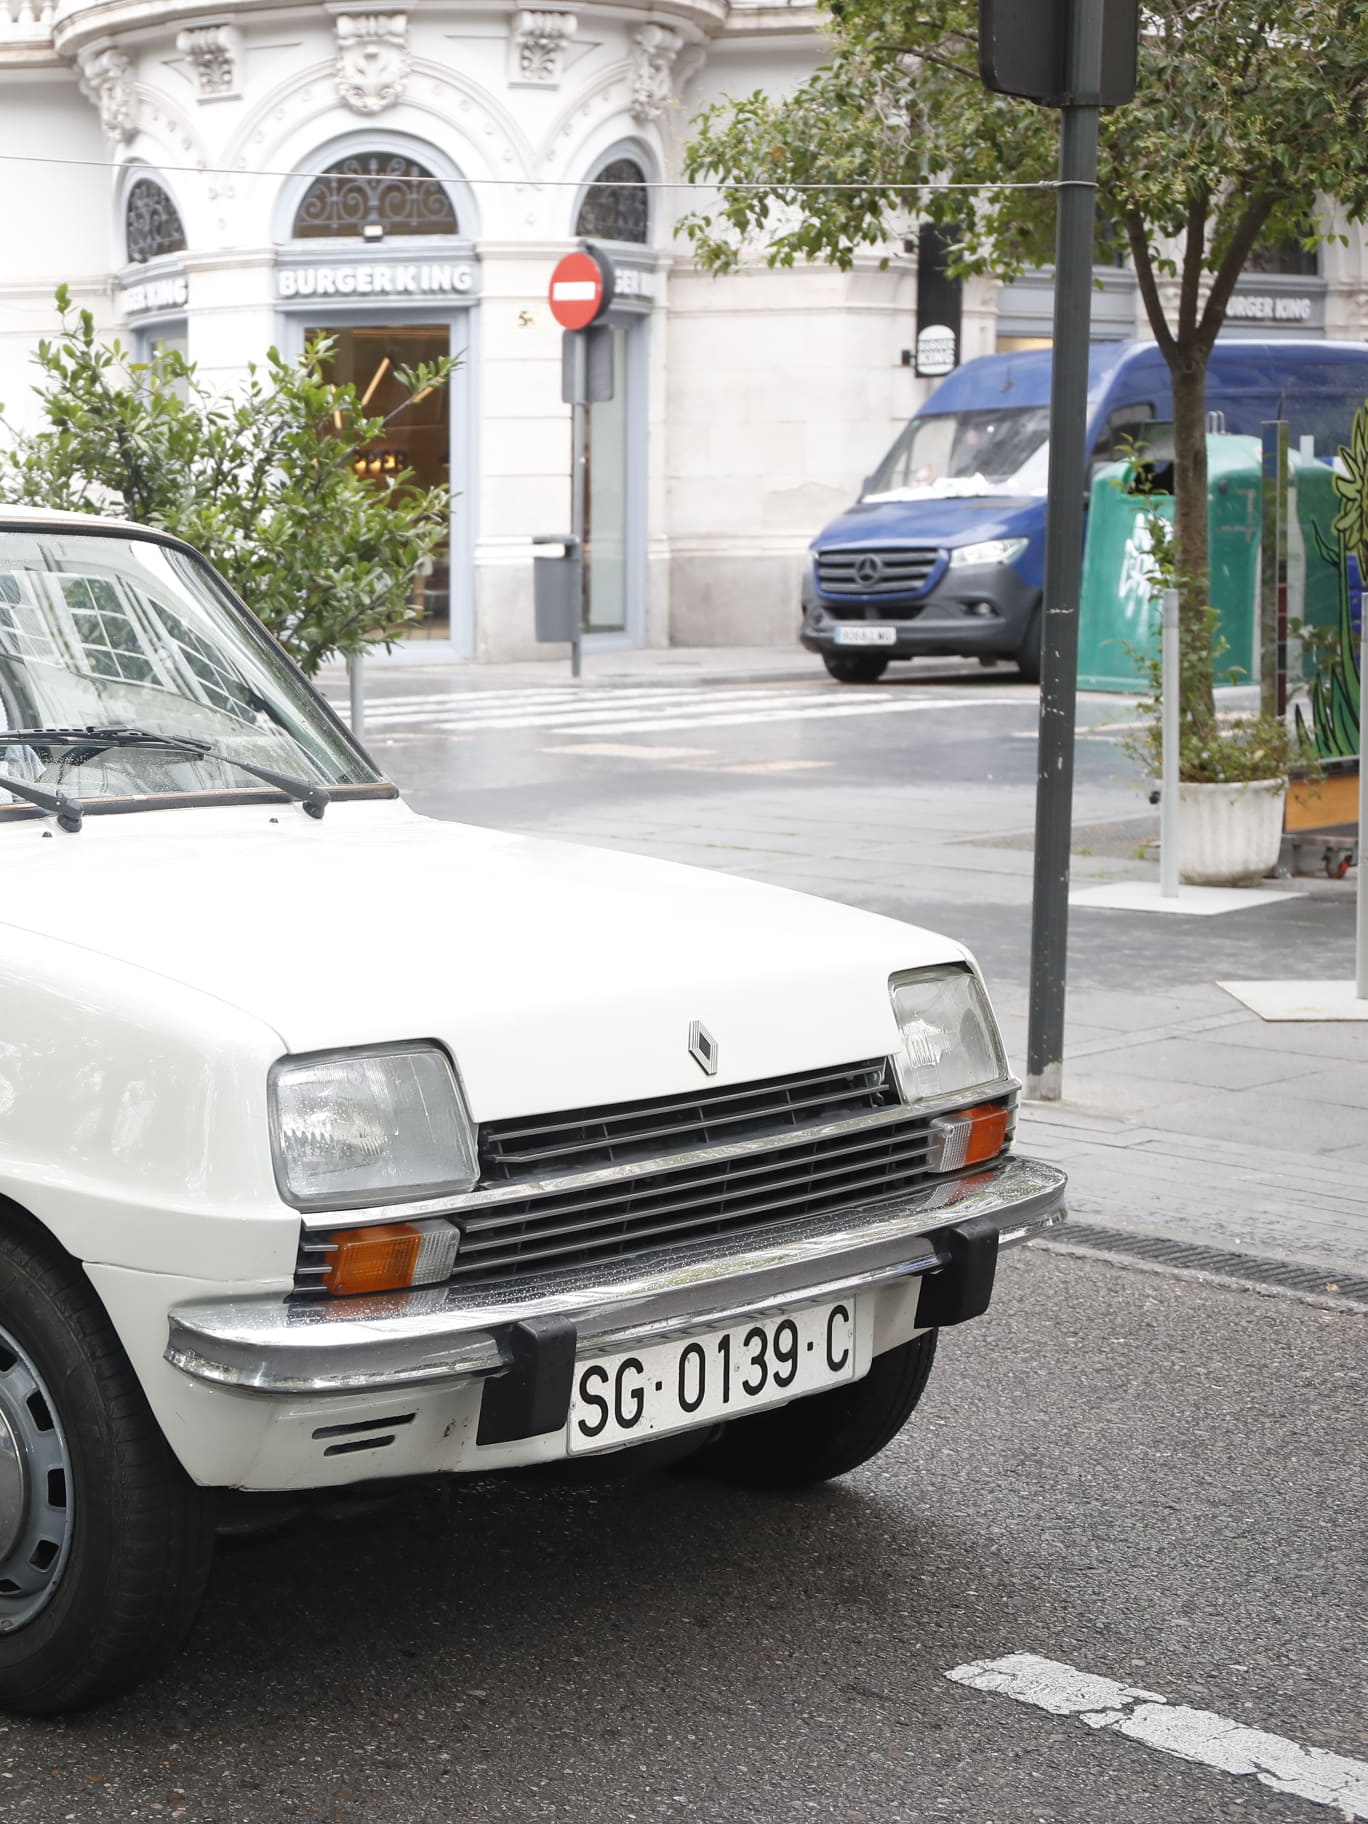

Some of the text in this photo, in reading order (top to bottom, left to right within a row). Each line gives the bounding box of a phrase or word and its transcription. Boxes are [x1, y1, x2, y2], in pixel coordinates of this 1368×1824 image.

[279, 264, 473, 296] BURGER KING
[1275, 298, 1311, 319] KING
